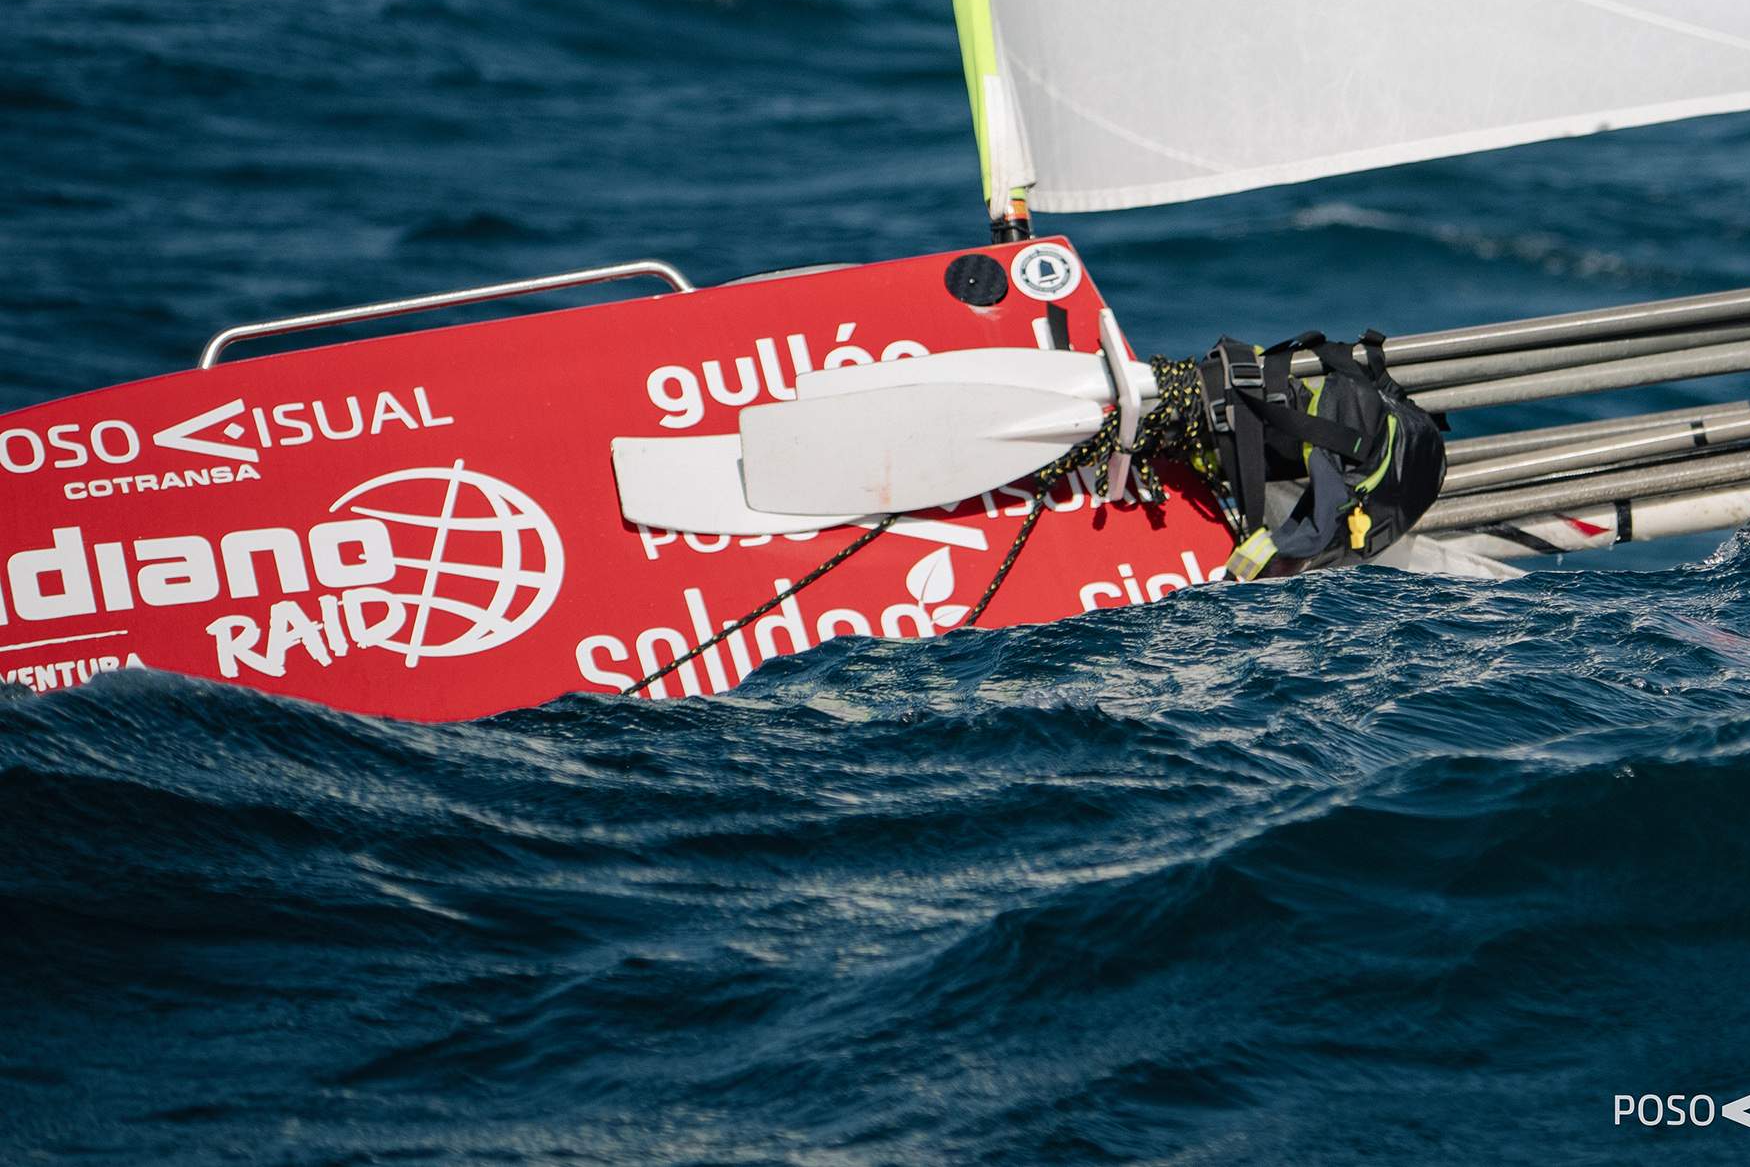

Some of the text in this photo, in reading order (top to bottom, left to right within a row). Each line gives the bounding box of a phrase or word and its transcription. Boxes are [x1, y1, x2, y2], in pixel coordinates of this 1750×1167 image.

[63, 463, 262, 500] COTRANSA
[0, 518, 396, 625] diano
[205, 588, 407, 679] RAID
